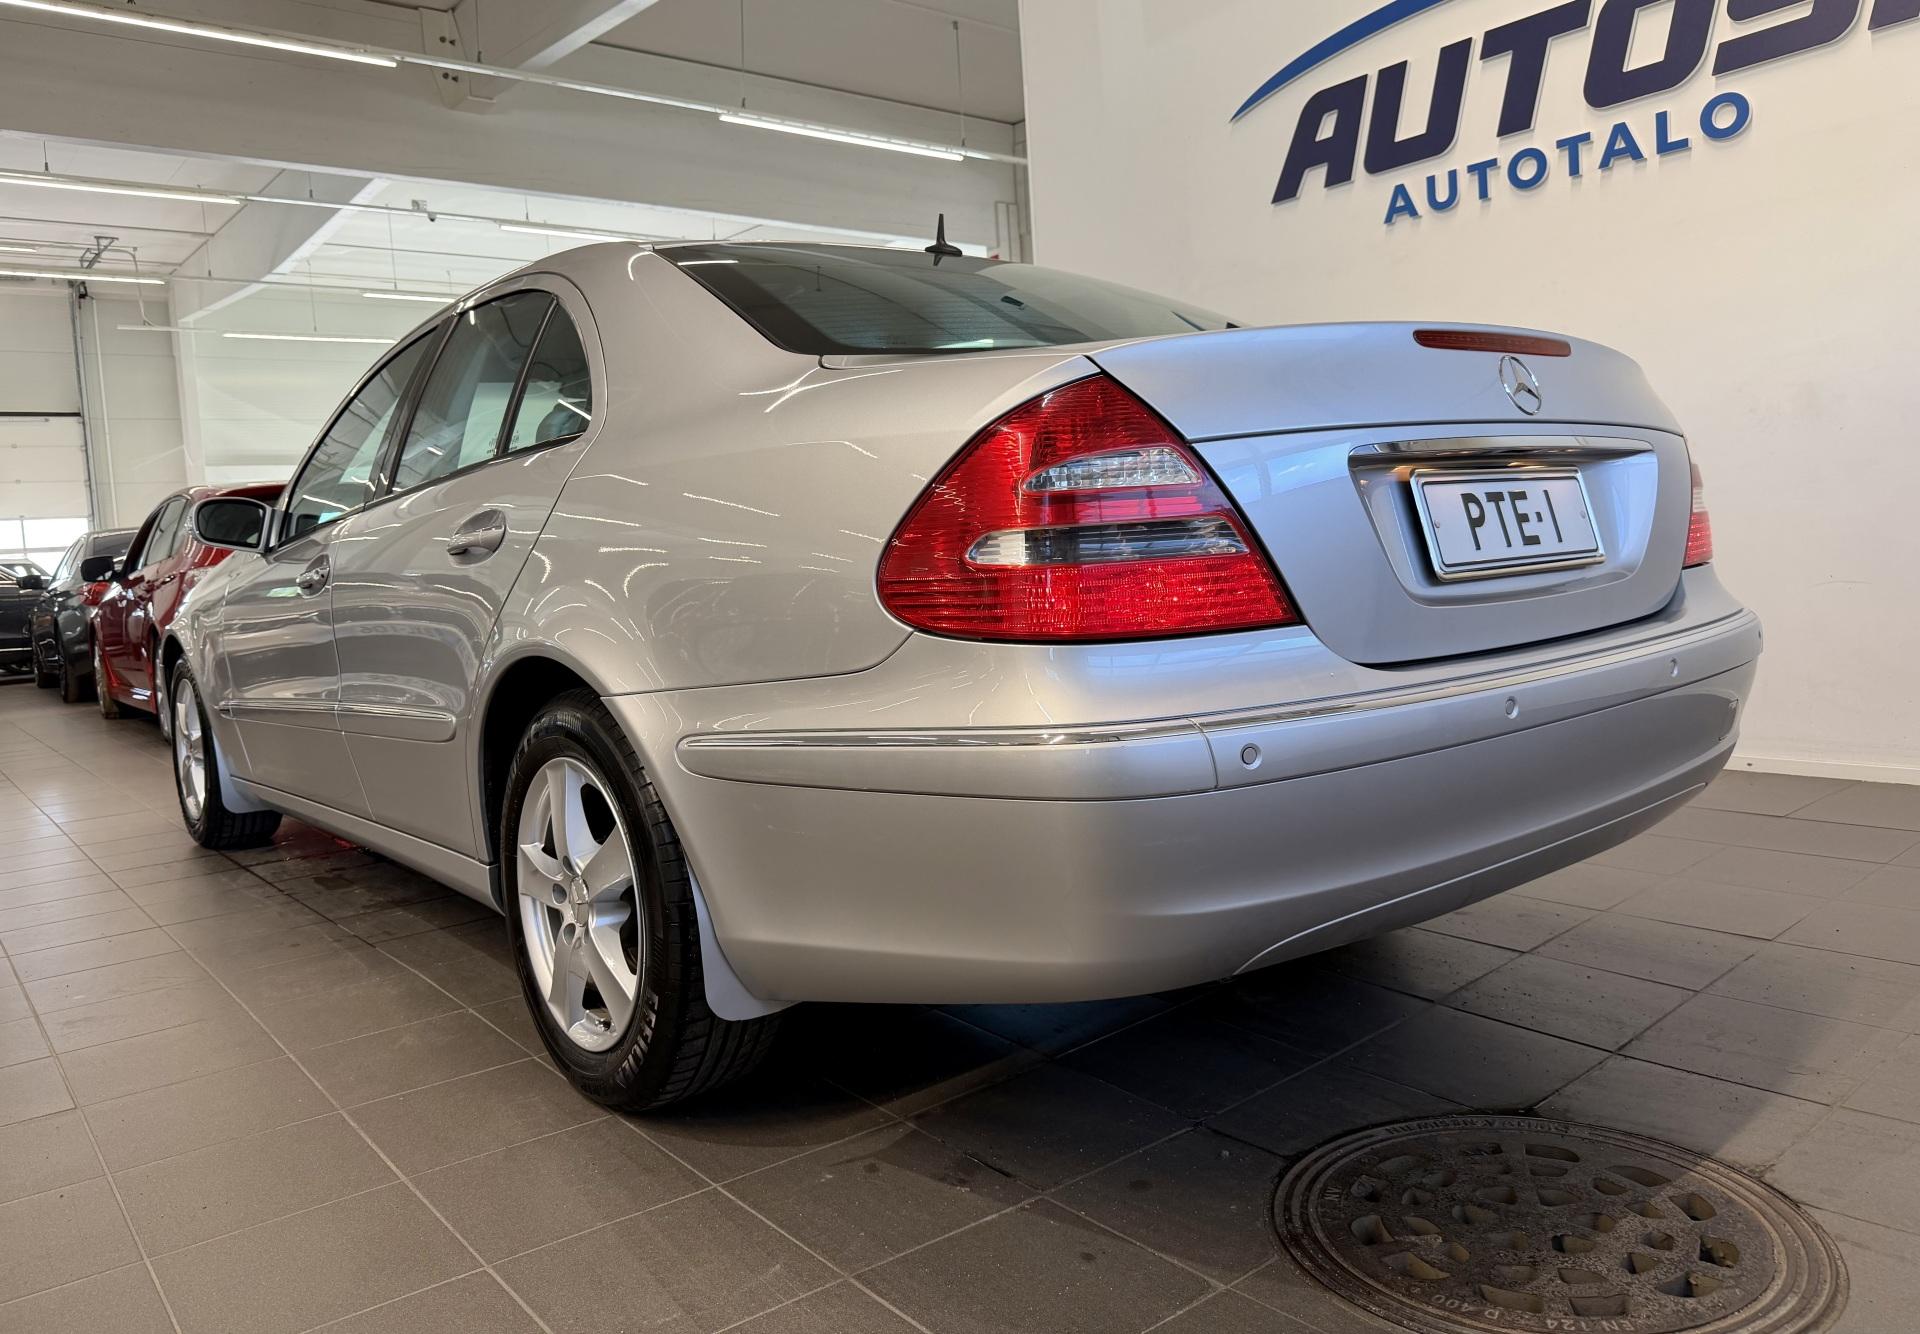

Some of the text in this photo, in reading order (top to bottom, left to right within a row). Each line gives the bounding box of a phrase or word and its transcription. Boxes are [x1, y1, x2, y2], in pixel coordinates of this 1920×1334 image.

[1270, 0, 1920, 205] AUTOS
[1384, 92, 1752, 225] AUTOTALO
[1430, 1294, 1500, 1320] D 400
[1546, 1319, 1636, 1332] EN 124
